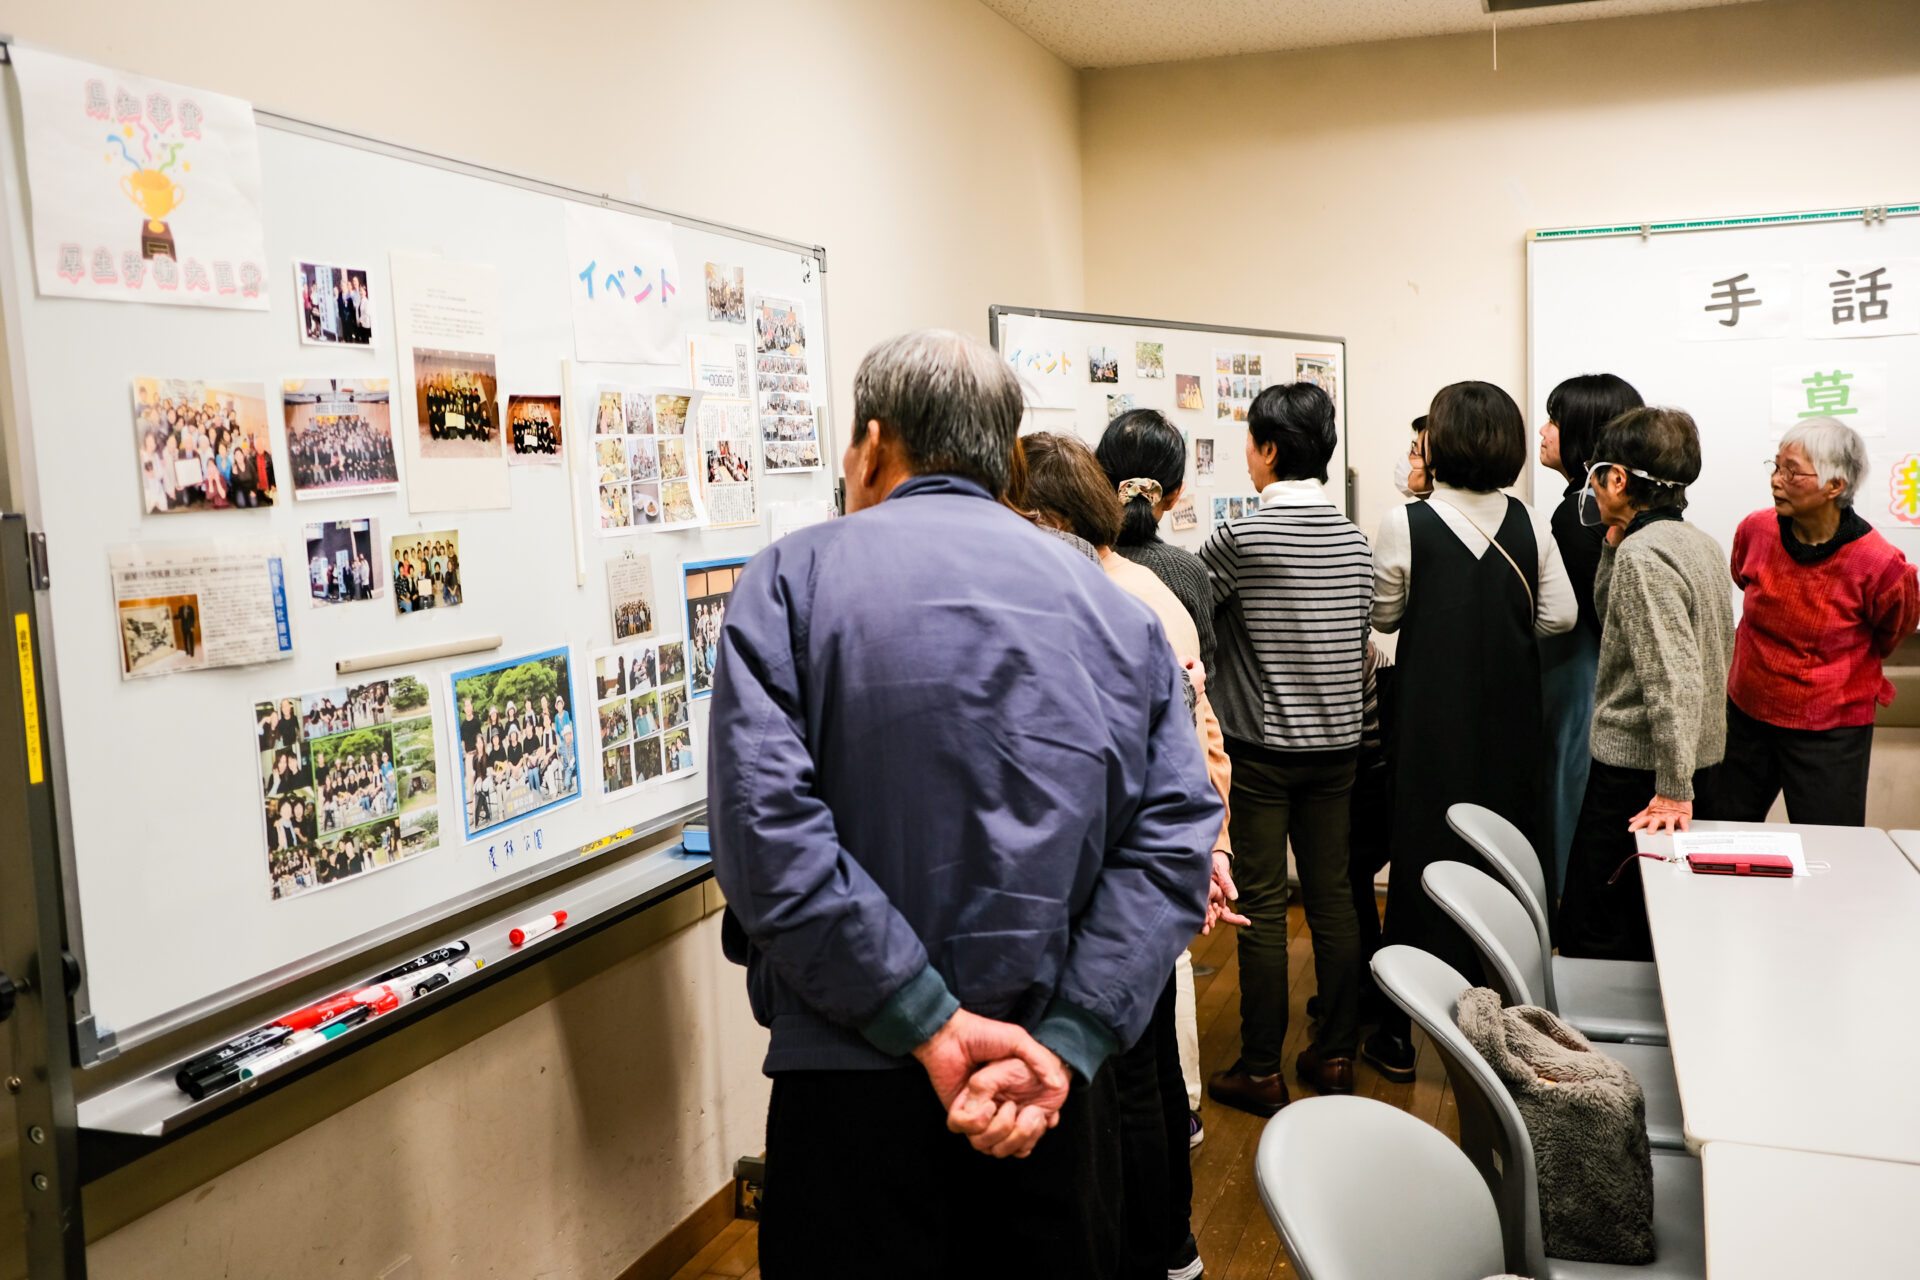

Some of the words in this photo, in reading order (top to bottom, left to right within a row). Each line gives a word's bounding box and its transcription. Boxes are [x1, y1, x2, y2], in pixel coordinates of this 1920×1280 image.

[58, 244, 261, 298] 厚生労働大臣賞
[579, 260, 675, 303] イベント
[1010, 349, 1071, 375] イベント
